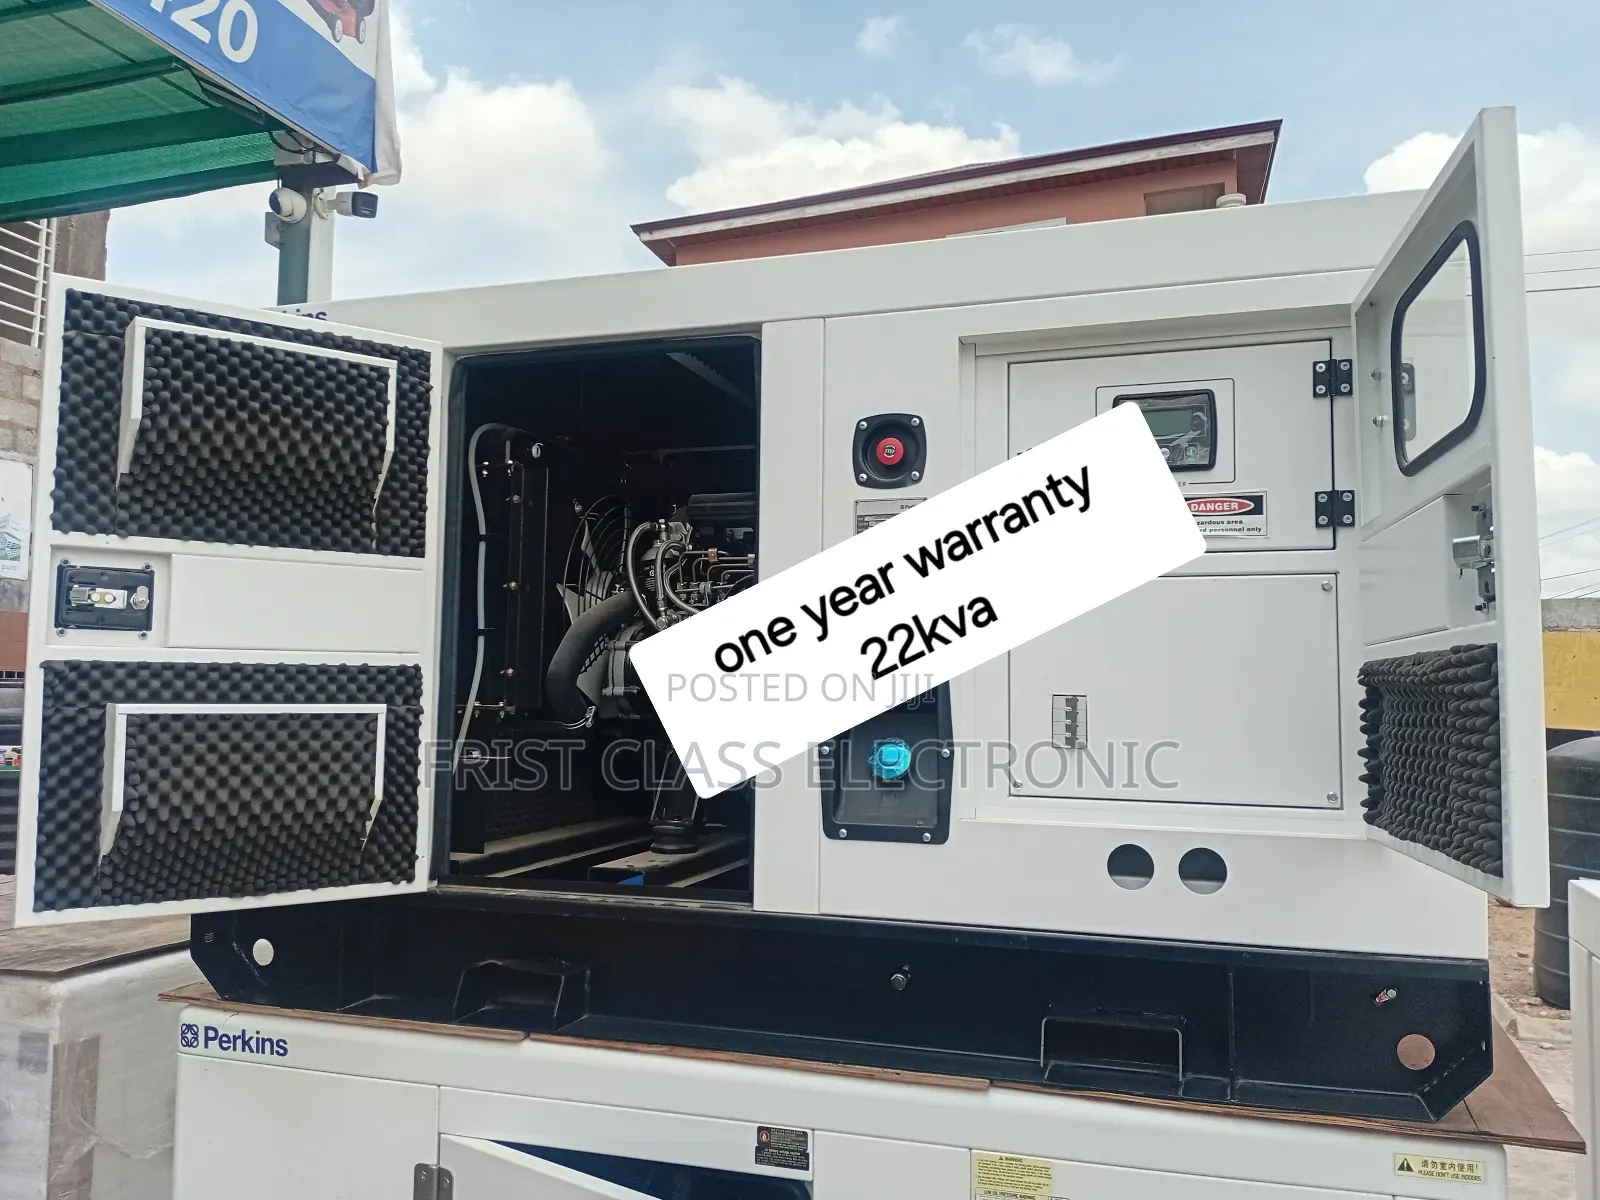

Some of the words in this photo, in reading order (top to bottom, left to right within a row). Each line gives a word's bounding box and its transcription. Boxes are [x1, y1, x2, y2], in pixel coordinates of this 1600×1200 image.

[150, 0, 259, 64] 20
[1190, 502, 1239, 512] DANGER
[203, 1025, 289, 1057] Perkins
